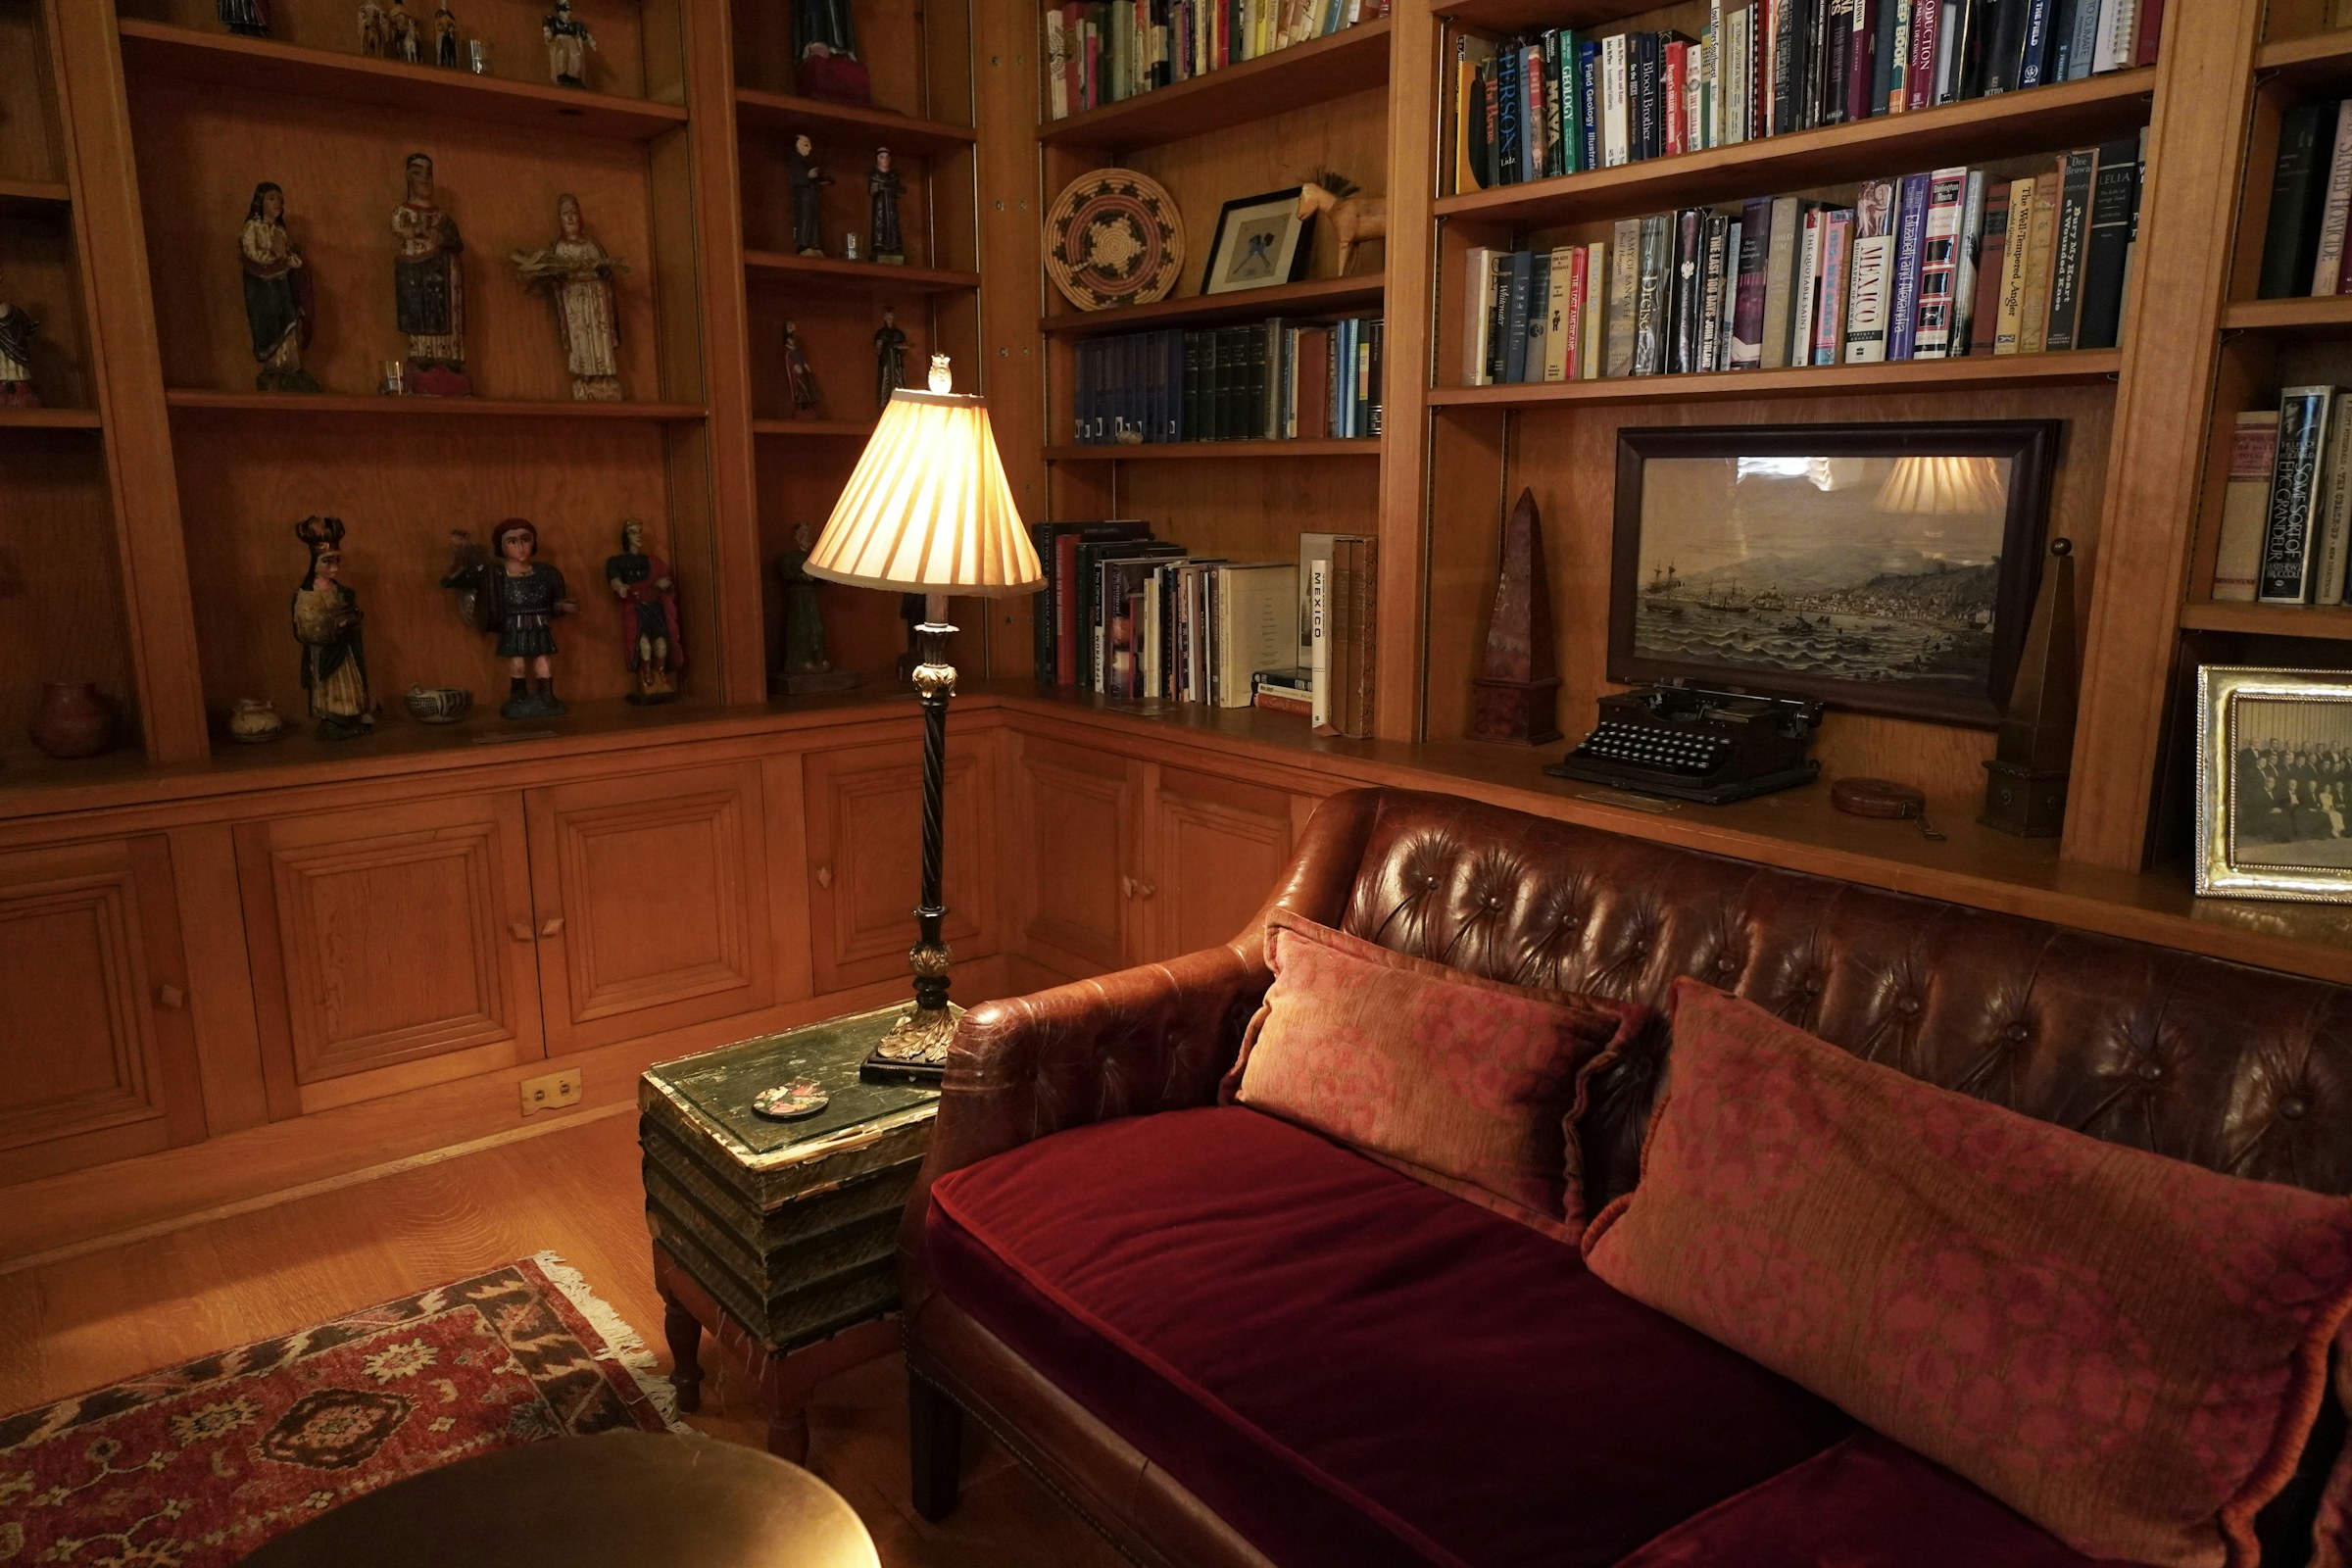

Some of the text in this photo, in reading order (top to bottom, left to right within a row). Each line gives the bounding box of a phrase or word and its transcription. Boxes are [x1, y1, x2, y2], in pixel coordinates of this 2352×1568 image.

[1893, 25, 1906, 70] BOOK
[1912, 30, 1921, 67] DECISIONS
[2031, 20, 2041, 47] FIELD
[2080, 1, 2096, 57] TO CLIMATE
[1585, 63, 1593, 87] Field
[1710, 43, 1718, 78] Southwest
[1499, 54, 1516, 153] PERSON
[1546, 79, 1560, 148] MAYA
[1561, 66, 1573, 120] GEOLOGY
[1586, 88, 1594, 127] Geology
[1643, 61, 1653, 141] Blood Brother
[1500, 156, 1517, 167] Lidz
[2066, 166, 2091, 176] Brown
[2072, 157, 2087, 166] Dee
[2099, 172, 2131, 185] LELIA
[2005, 186, 2031, 317] The Well-Tempered Angler
[2055, 199, 2072, 311] at Wounded Knee
[2063, 206, 2081, 303] Bury My Heart
[2322, 198, 2350, 261] HOMICIDE
[1803, 253, 1813, 303] QUOTABLE
[1851, 243, 1860, 288] BIOGRAPHY
[1855, 246, 1883, 323] MEXICO
[1894, 214, 1918, 333] Elizabeth and Alexandra
[1498, 284, 1509, 327] Whitewater
[1639, 275, 1658, 334] Dreiser
[1702, 235, 1721, 368] THE LAST 100 DAYS JOHN TOLAND
[1800, 304, 1809, 331] SAINT
[1850, 290, 1856, 299] OF
[2267, 461, 2295, 562] EPIC GRANDEUR
[2285, 463, 2312, 559] SOME SORT OF
